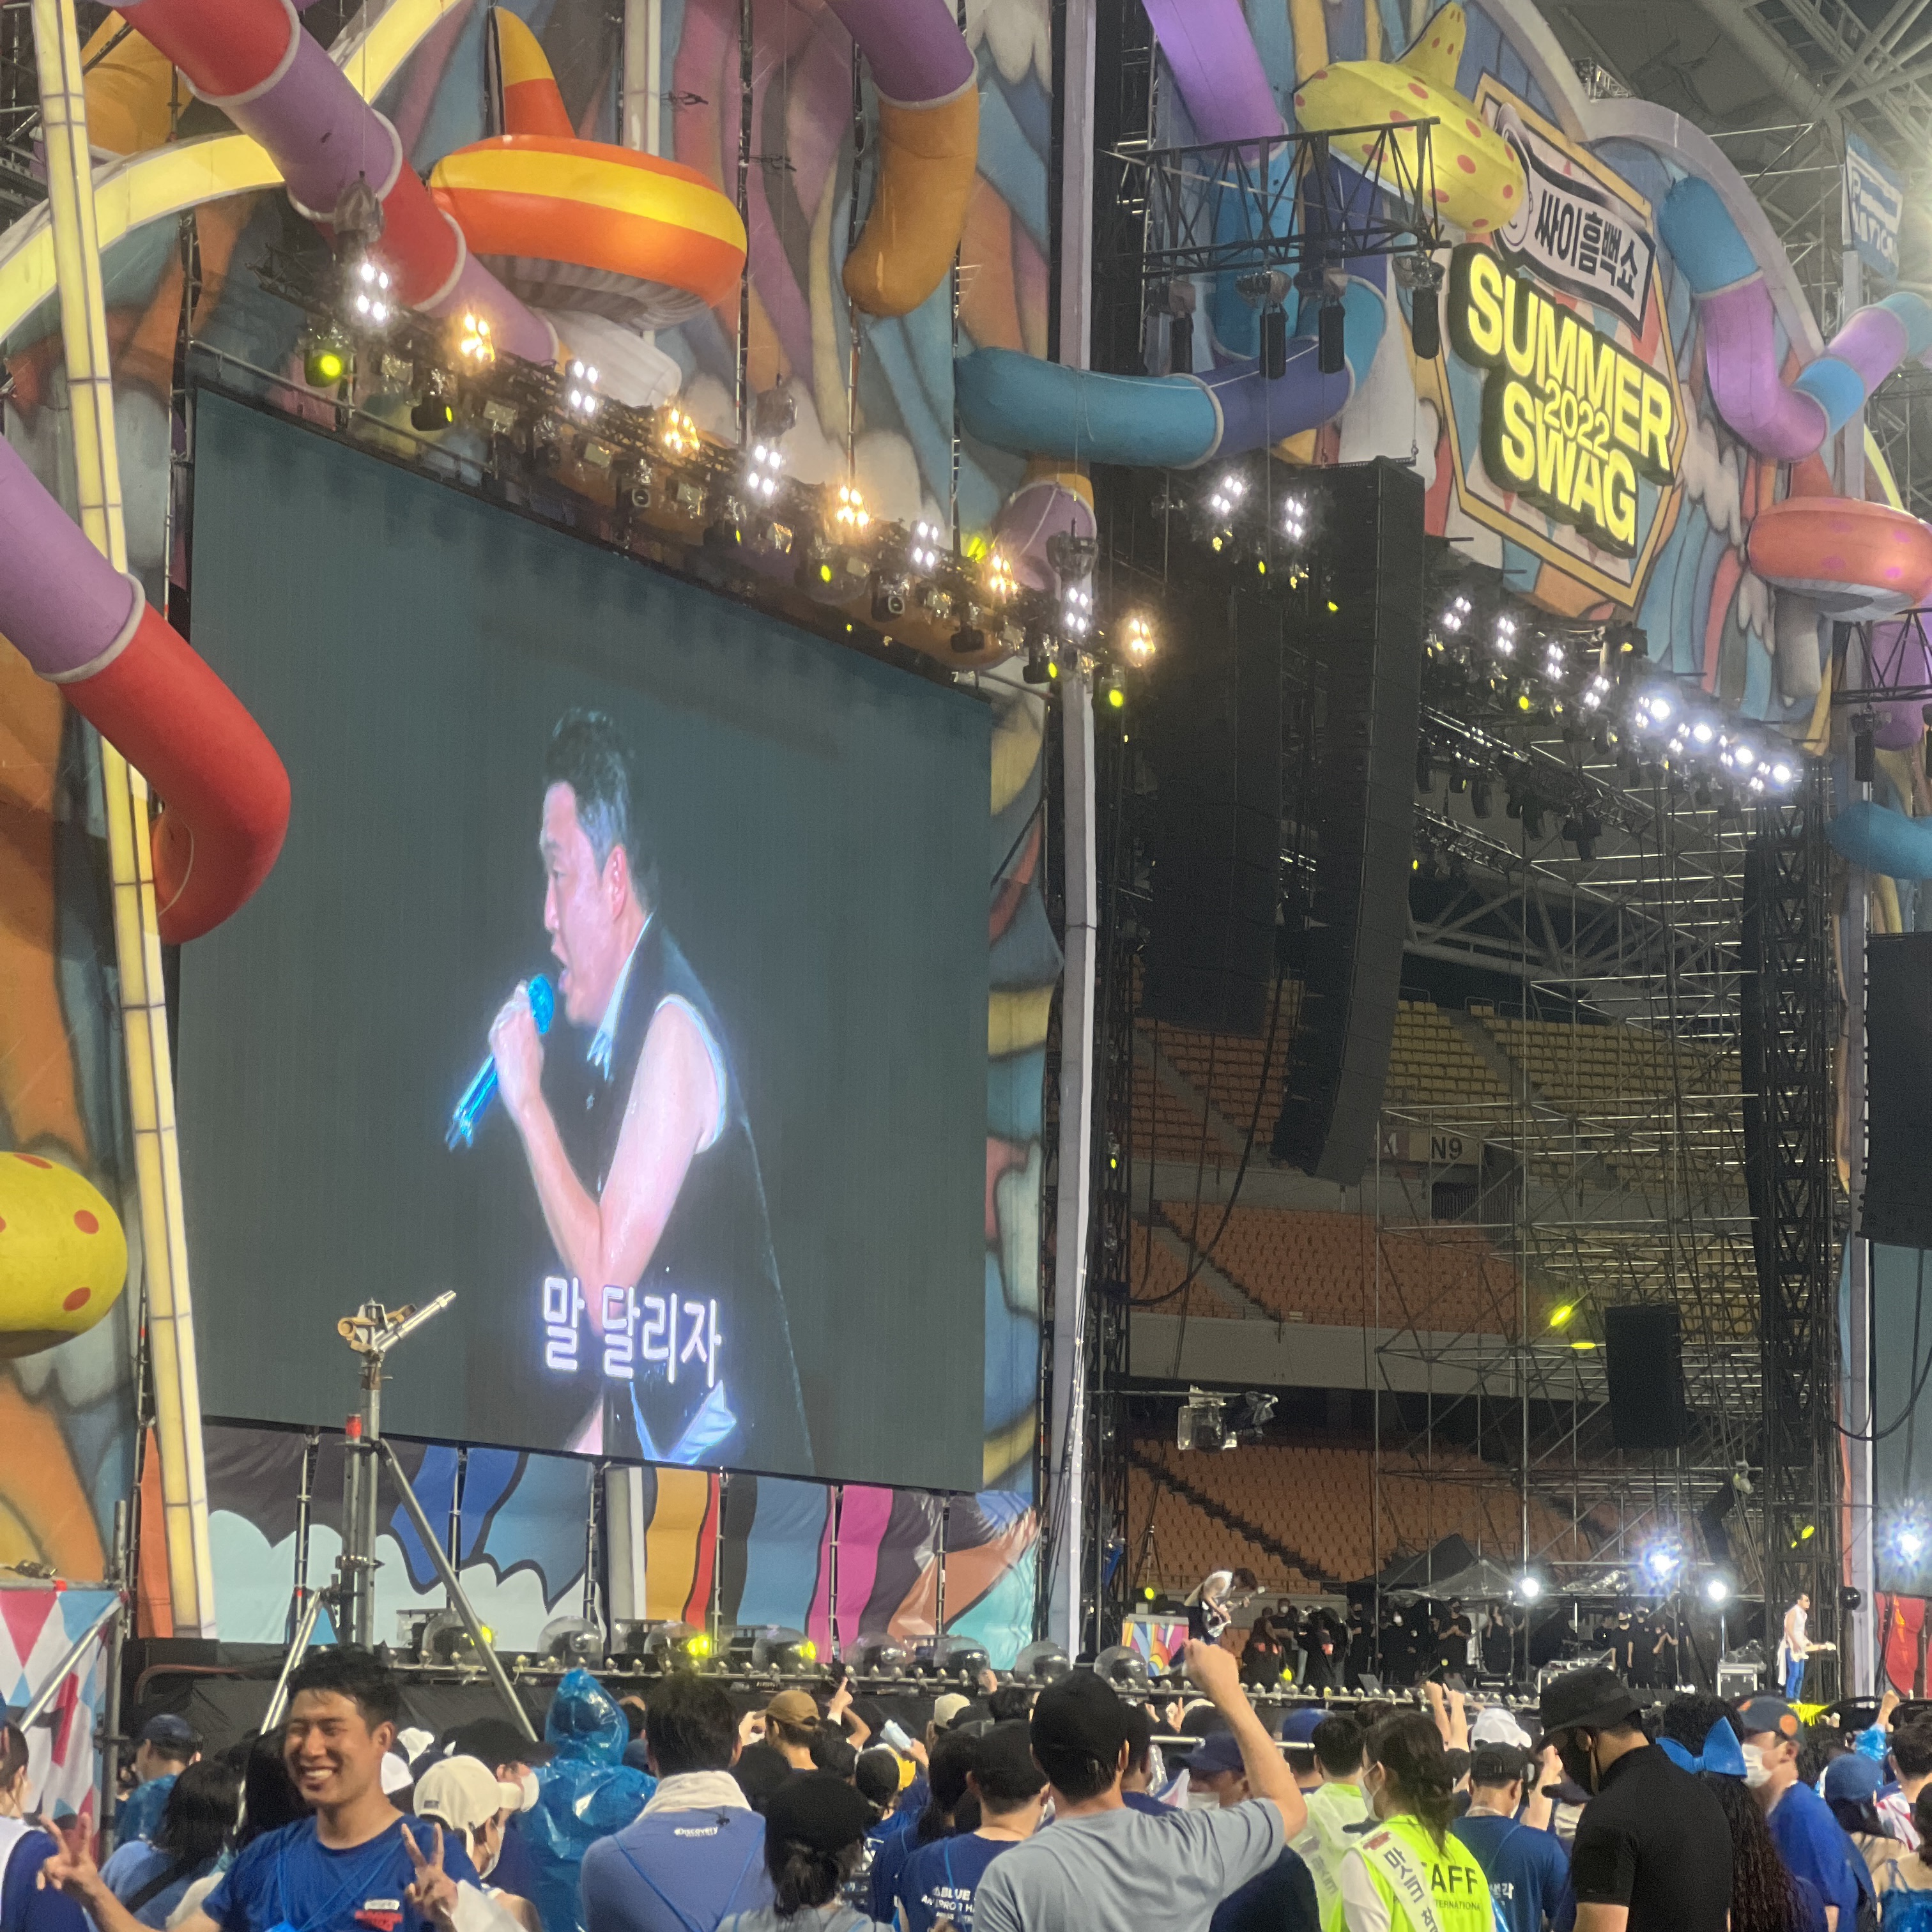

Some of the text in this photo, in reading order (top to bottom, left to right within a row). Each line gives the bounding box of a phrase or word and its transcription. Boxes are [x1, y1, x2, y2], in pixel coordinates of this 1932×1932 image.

[1468, 253, 1672, 471] SUMMER
[1544, 379, 1610, 460] 2022
[1502, 381, 1636, 546] SWAG
[1431, 1137, 1463, 1160] N9
[543, 1276, 723, 1388] 말 달리자
[1383, 1847, 1425, 1904] 마스크
[1421, 1862, 1478, 1895] AFF
[1435, 1899, 1481, 1911] TERNATIONA
